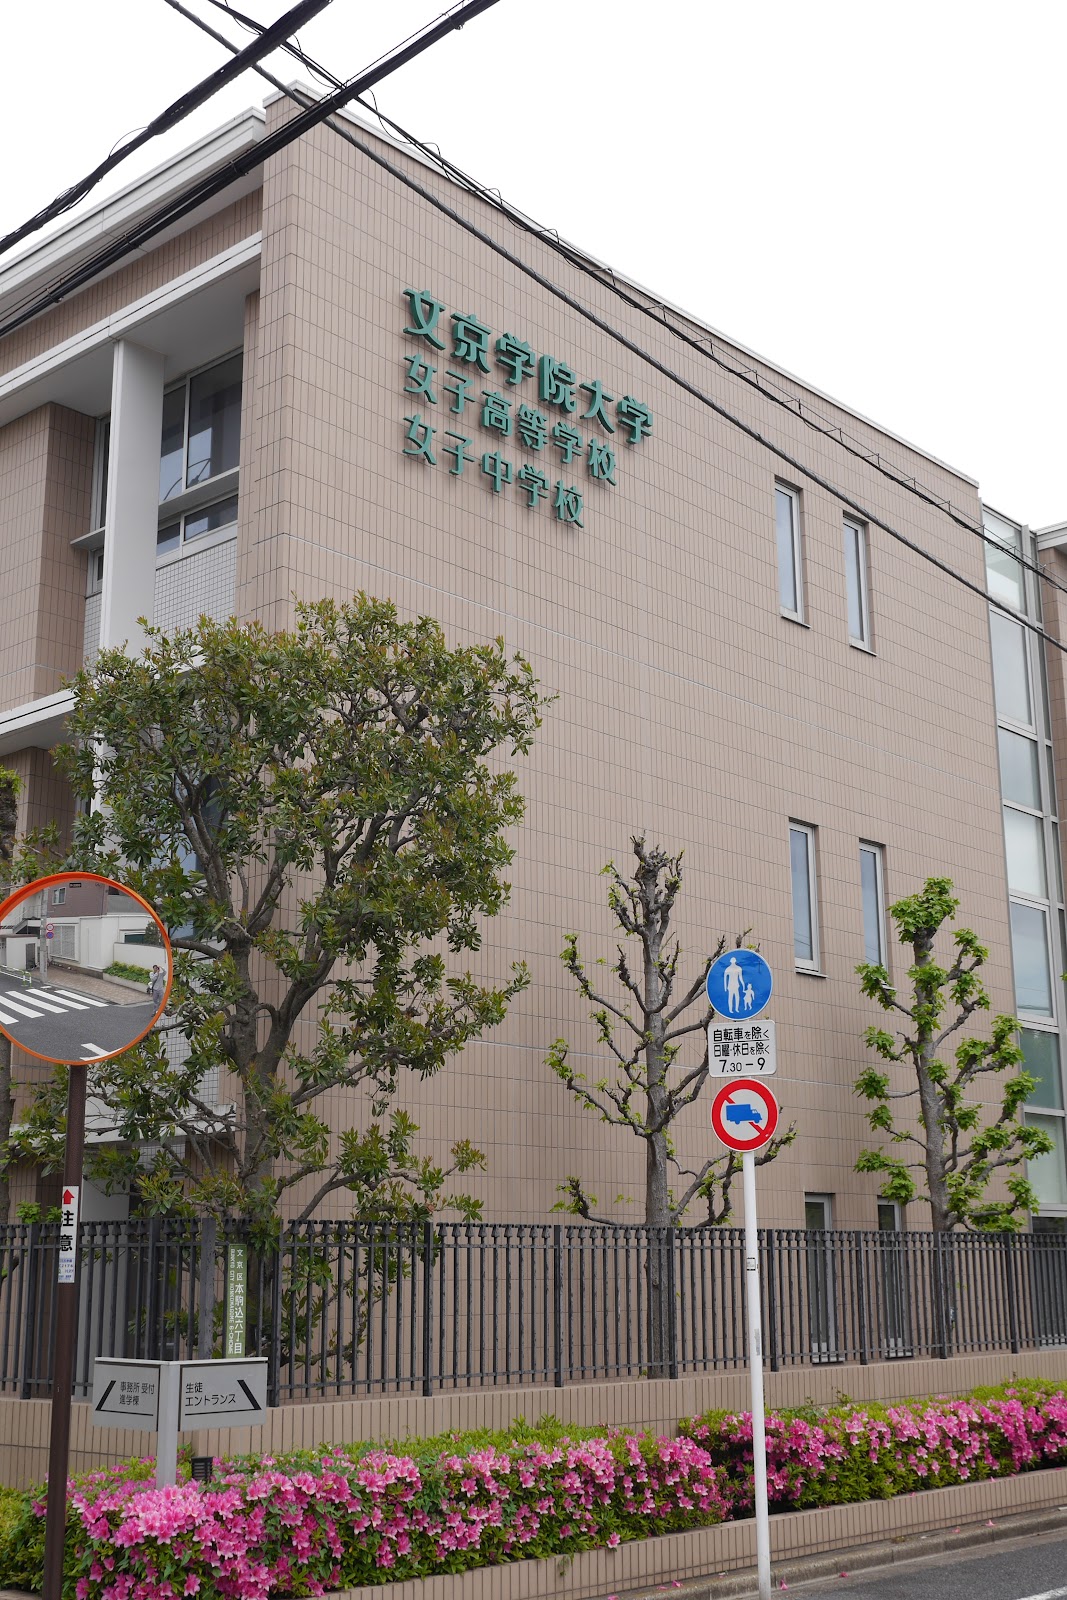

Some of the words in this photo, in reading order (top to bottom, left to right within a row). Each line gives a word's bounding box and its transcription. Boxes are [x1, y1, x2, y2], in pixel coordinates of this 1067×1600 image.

[403, 288, 653, 445] 文京学院大学
[403, 353, 617, 486] 女子高等学校
[402, 413, 584, 528] 女子中学校
[713, 1026, 770, 1042] 自転車を除く
[60, 1209, 74, 1251] 注意
[185, 1382, 203, 1394] 生徒
[185, 1393, 237, 1407] エントランス
